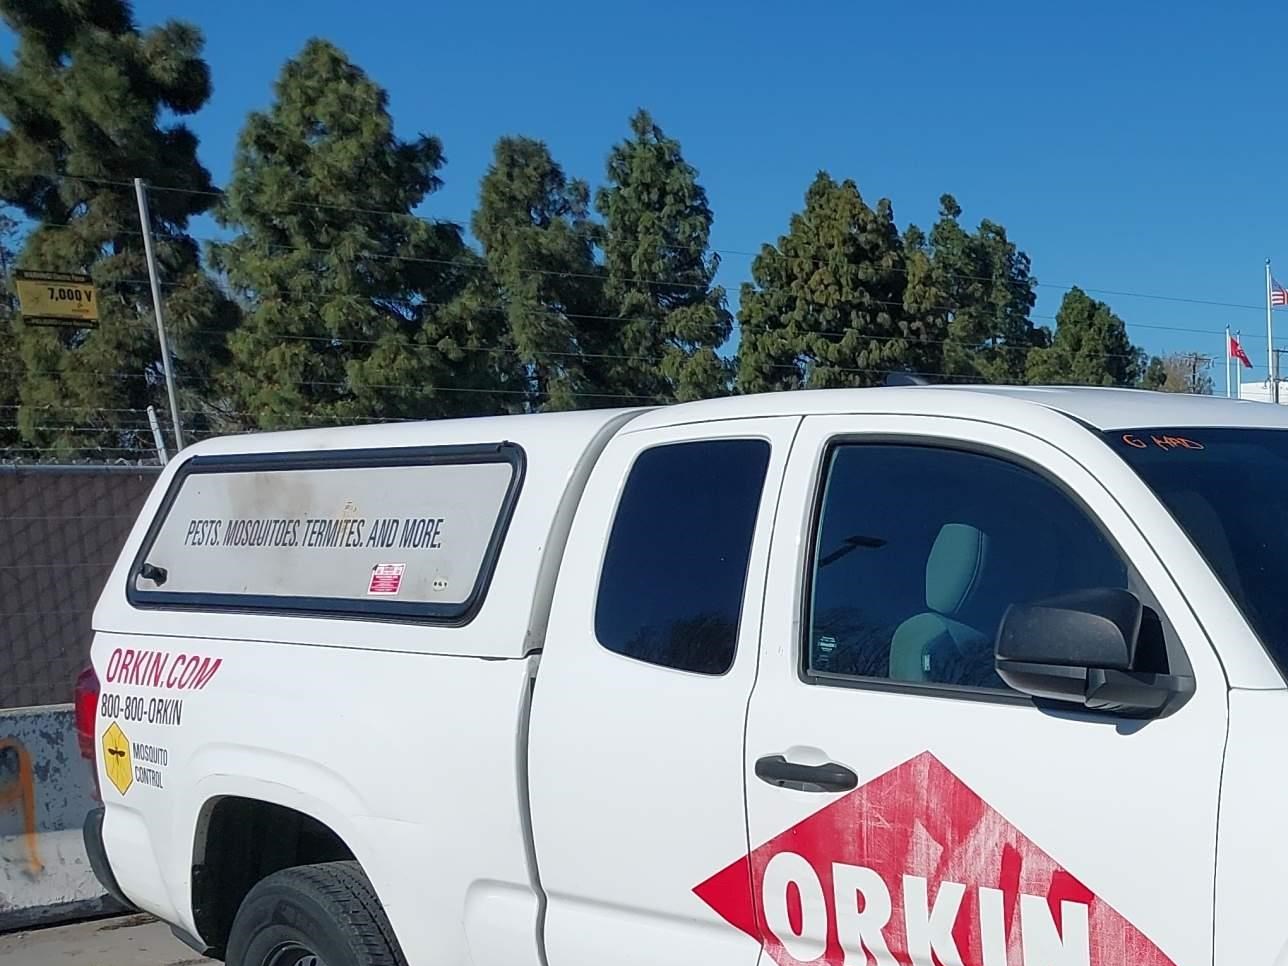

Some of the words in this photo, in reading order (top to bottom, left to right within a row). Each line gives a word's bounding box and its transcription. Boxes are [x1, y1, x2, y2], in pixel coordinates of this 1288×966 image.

[48, 288, 82, 302] 7,000
[84, 290, 92, 302] V
[185, 519, 220, 546] PESTS.
[222, 519, 300, 547] MOSQUITOES.
[302, 519, 365, 549] TERMITES.
[366, 518, 400, 549] AND
[399, 518, 444, 549] MORE.
[106, 647, 223, 690] ORKIN.COM
[101, 692, 183, 726] 800-800-ORKIN
[132, 742, 168, 767] MOSQUITO
[134, 765, 164, 789] CONTROL
